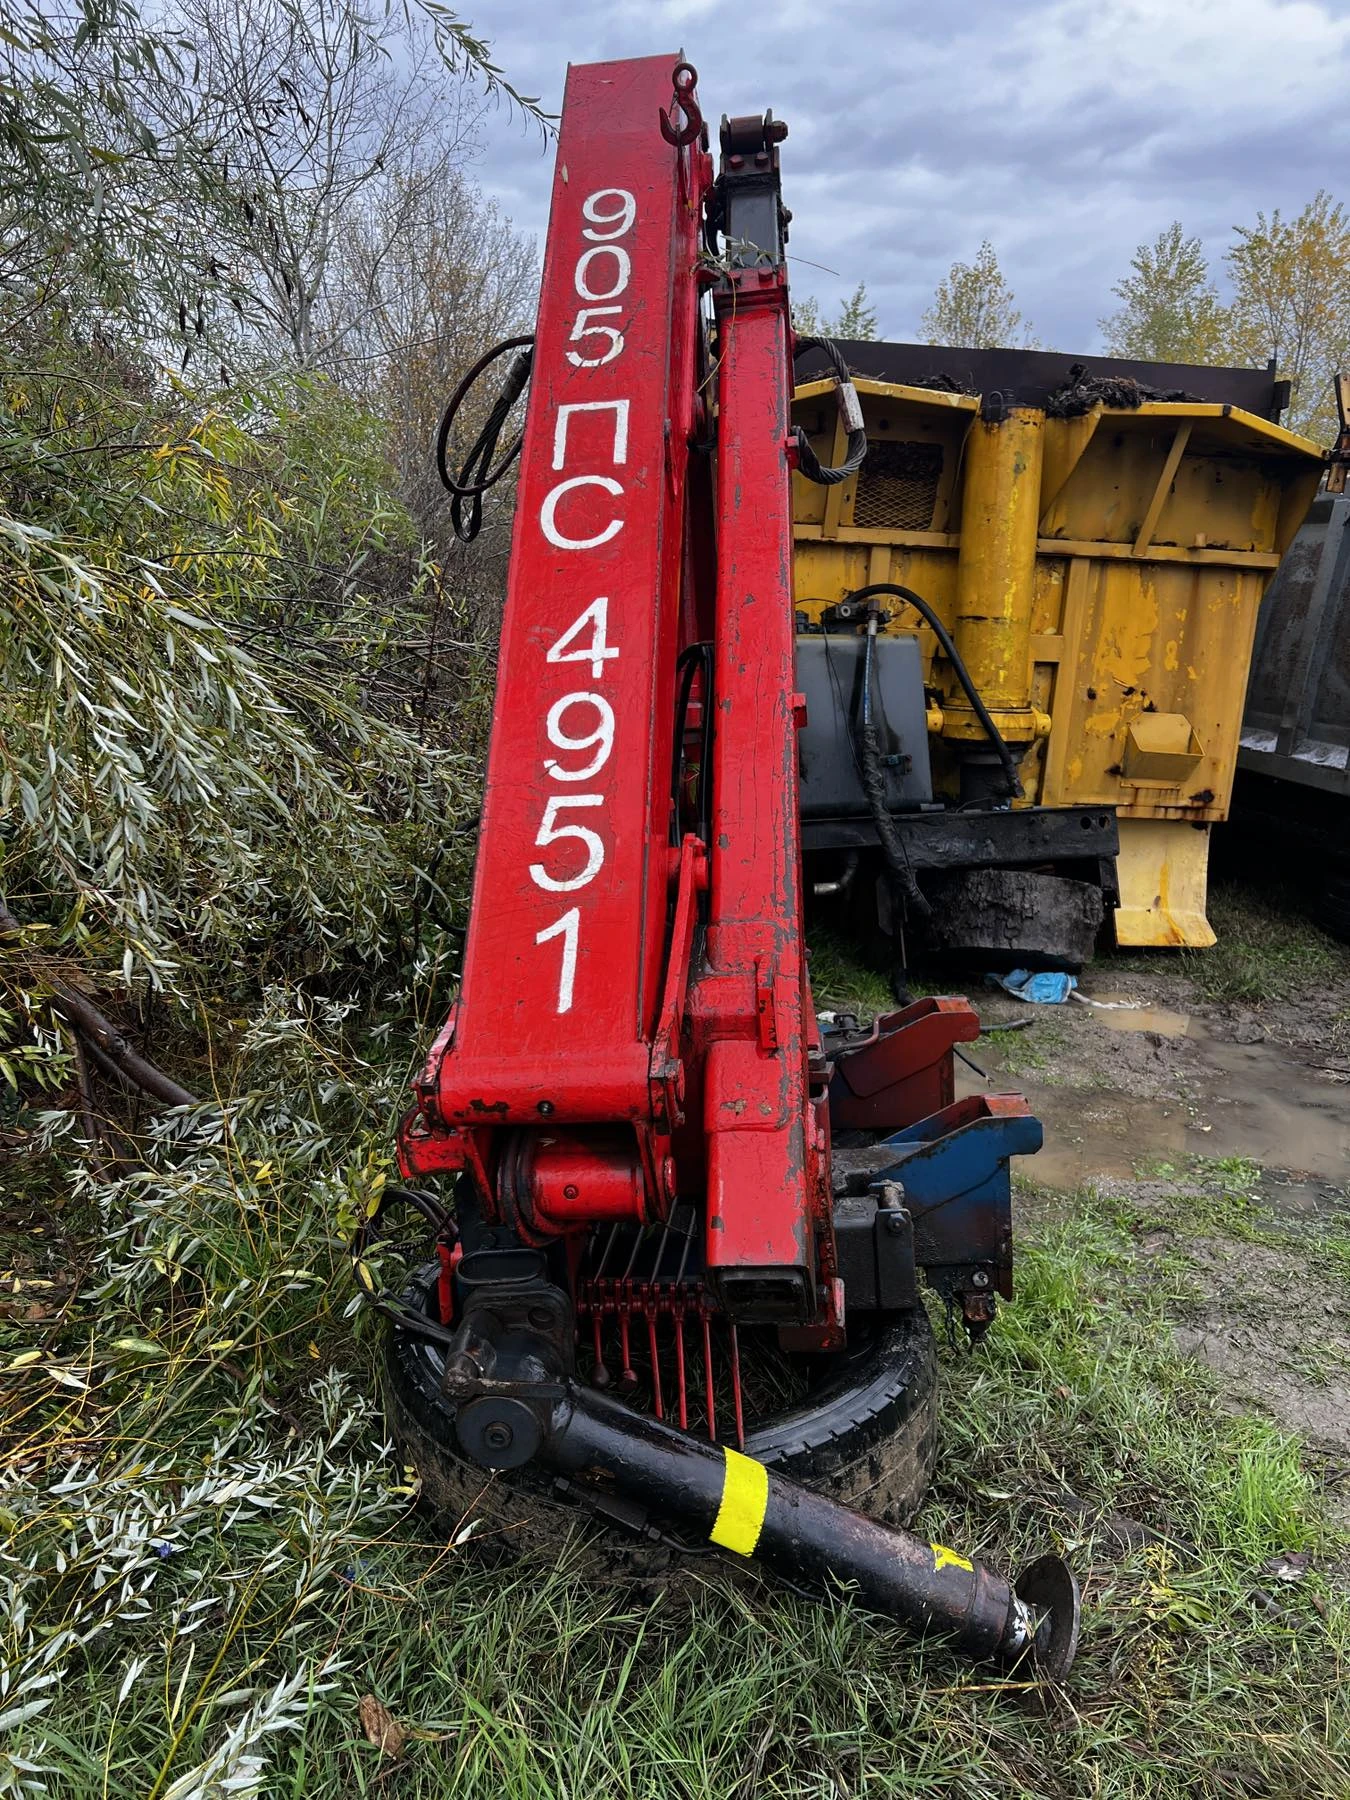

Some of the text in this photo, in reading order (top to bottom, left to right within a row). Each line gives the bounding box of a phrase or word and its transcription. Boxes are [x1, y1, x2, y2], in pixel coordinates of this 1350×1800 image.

[528, 188, 637, 1014] 905 ПС 4951
